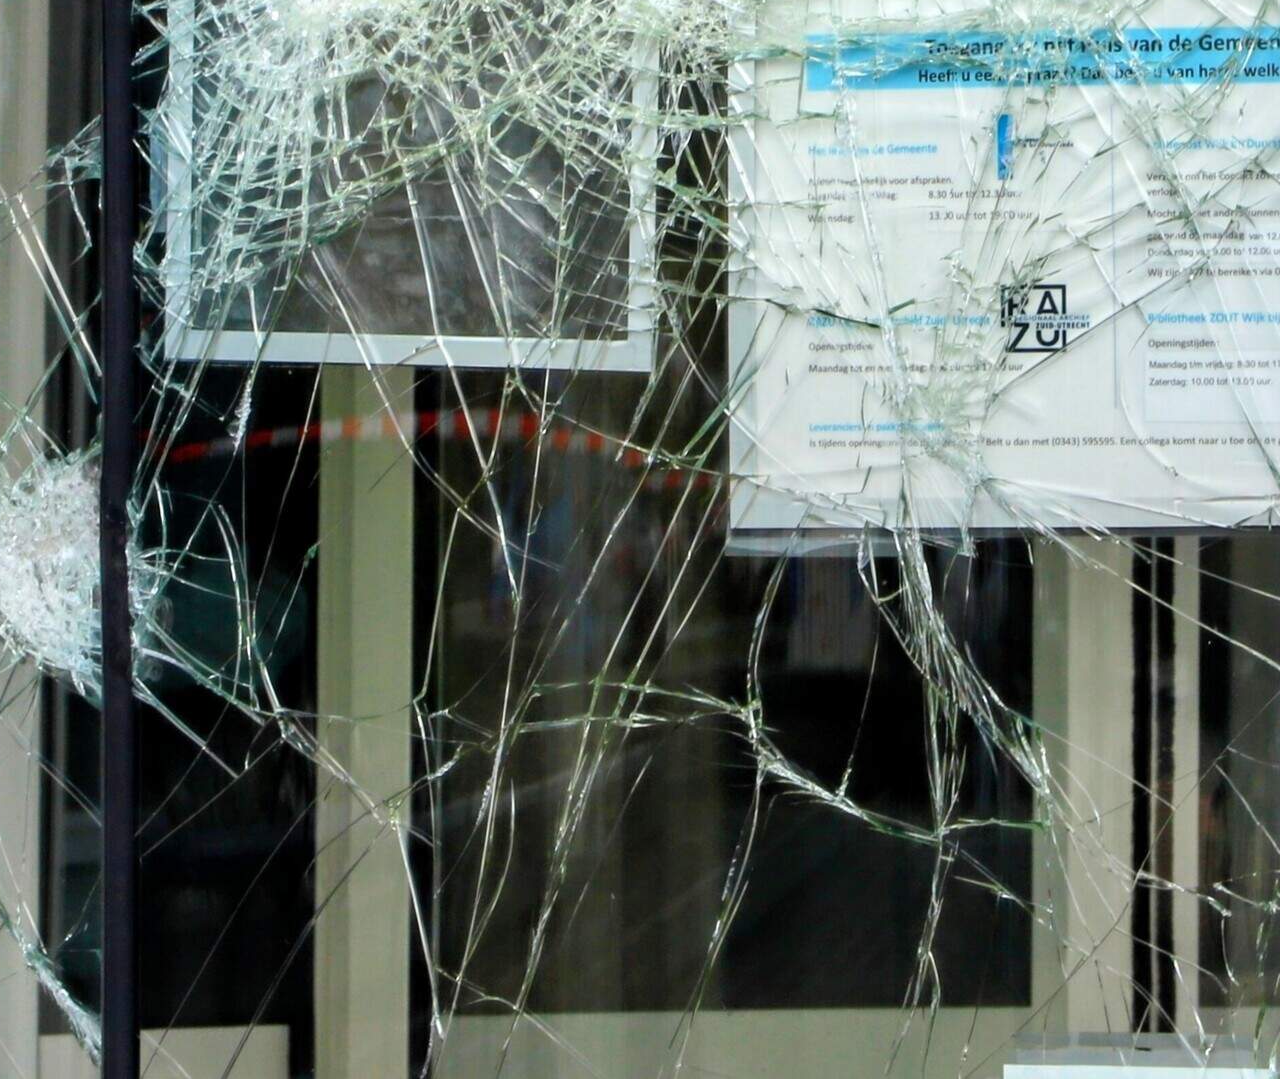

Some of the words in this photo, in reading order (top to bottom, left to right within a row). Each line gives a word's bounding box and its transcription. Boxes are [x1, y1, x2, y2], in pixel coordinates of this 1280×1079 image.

[925, 39, 1003, 57] Togang
[1128, 39, 1162, 52] van
[1169, 34, 1192, 52] de
[962, 71, 970, 82] u
[974, 71, 1002, 82] ee
[1167, 68, 1195, 78] van
[1014, 438, 1029, 446] dan
[1052, 438, 1079, 447] (0343)
[1173, 437, 1195, 445] komt
[1230, 437, 1245, 445] toe
